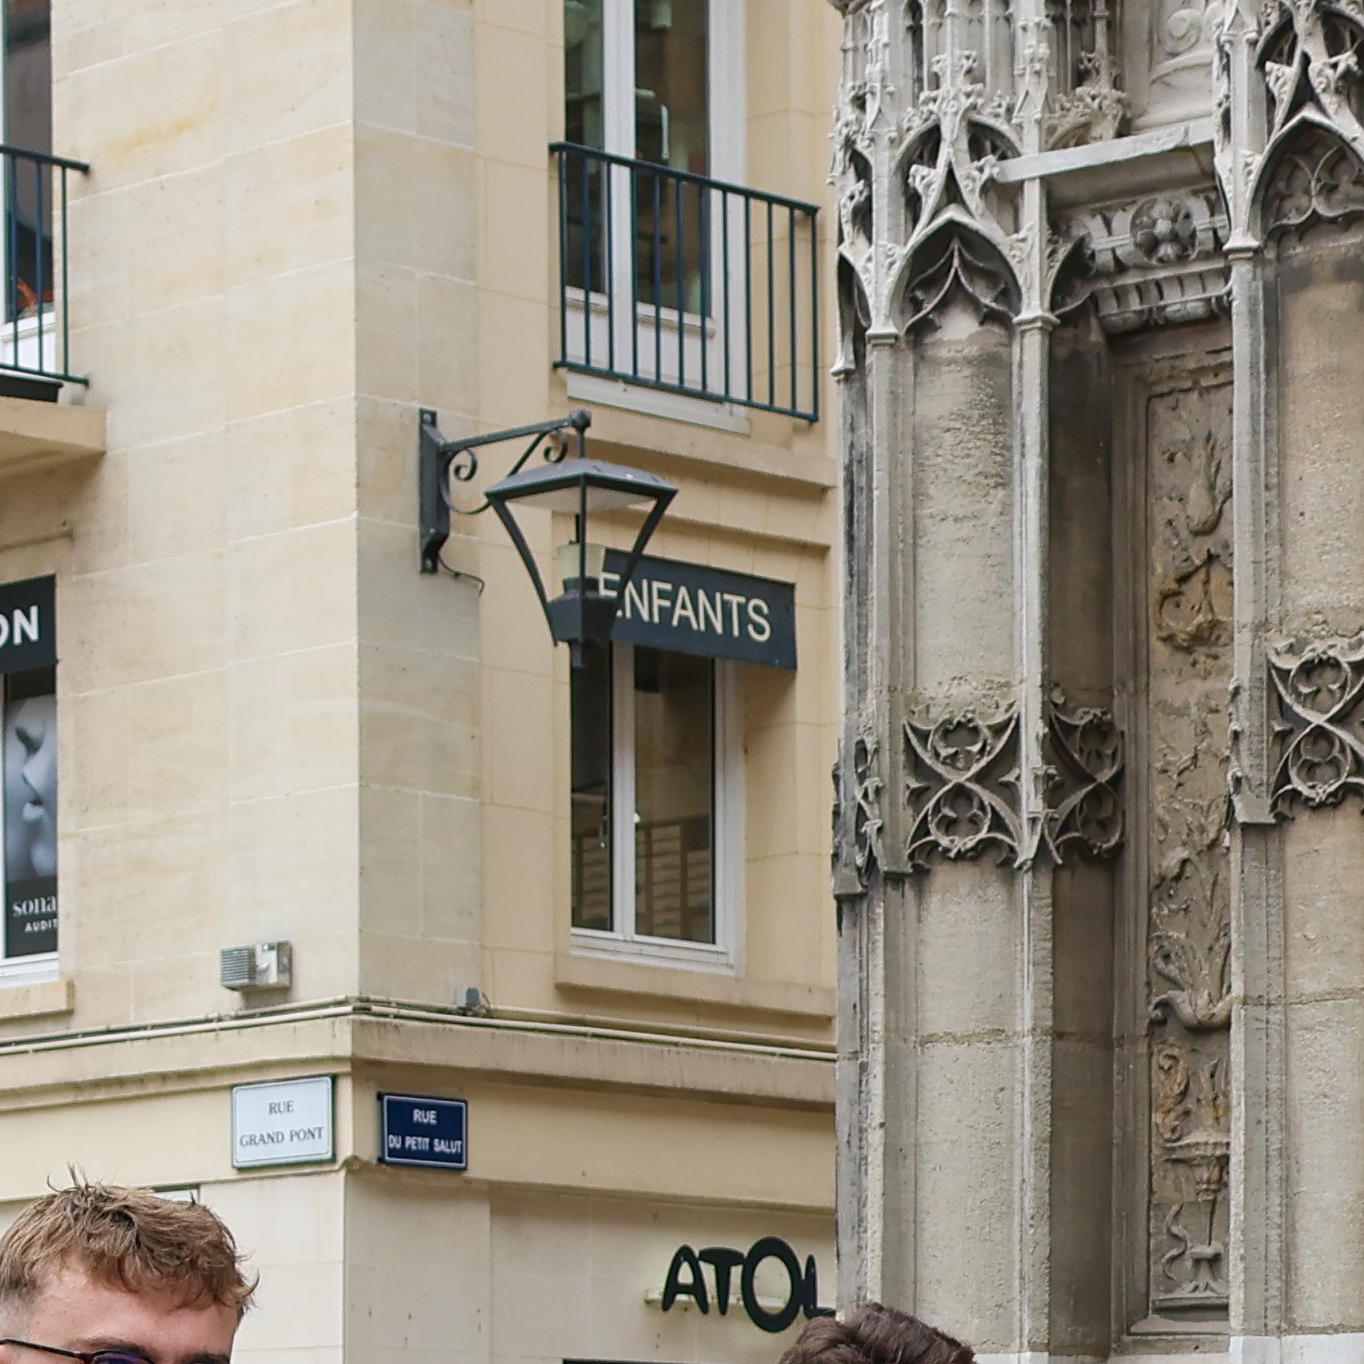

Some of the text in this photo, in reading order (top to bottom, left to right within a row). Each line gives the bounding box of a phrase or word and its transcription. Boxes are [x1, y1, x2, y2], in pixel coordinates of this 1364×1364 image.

[598, 571, 771, 642] ENFANTS
[268, 1101, 295, 1115] RUE
[412, 1108, 438, 1125] RUE
[239, 1126, 325, 1148] GRAND PONT
[388, 1134, 463, 1155] DU PETIT SALUT
[661, 1236, 837, 1333] ATOL
